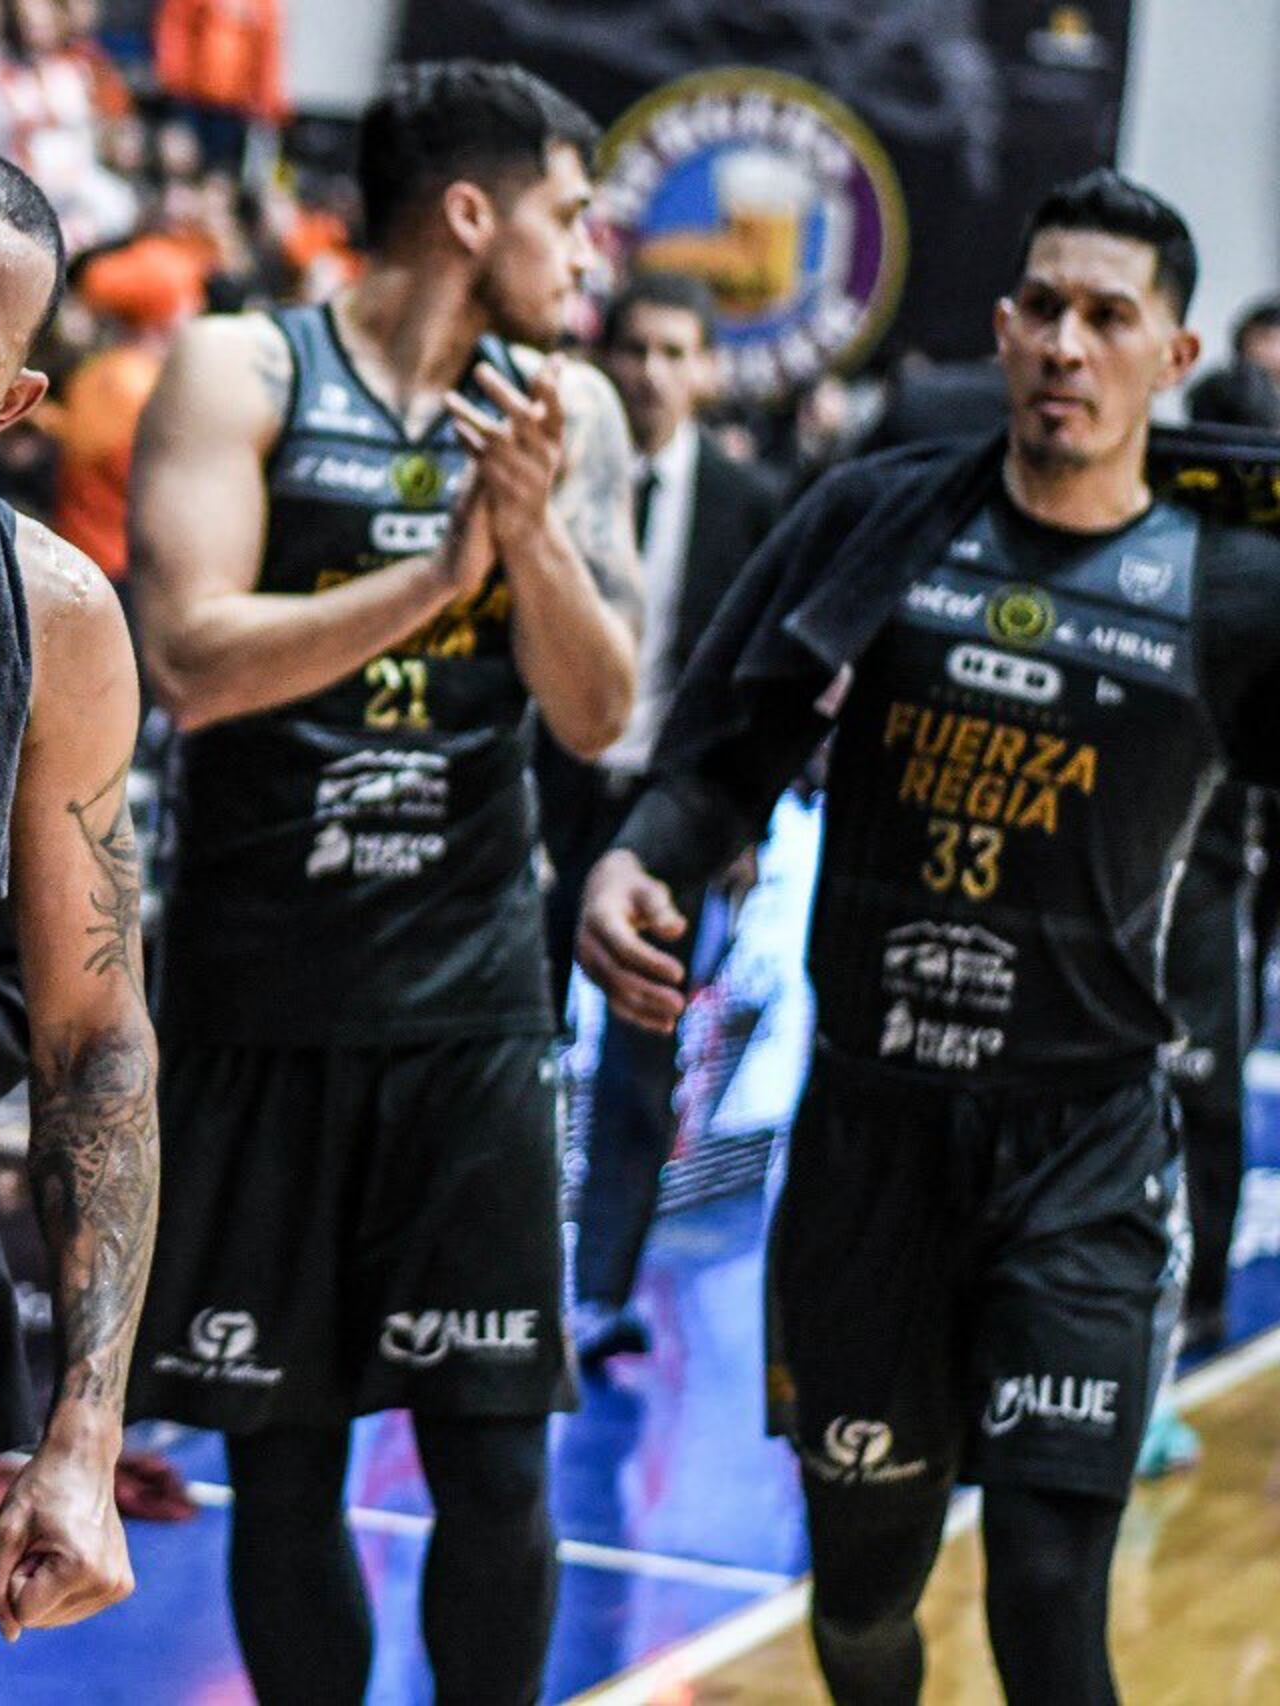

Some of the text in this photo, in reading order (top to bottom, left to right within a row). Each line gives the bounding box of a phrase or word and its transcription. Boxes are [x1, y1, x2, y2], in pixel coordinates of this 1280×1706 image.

[365, 657, 431, 731] 21
[883, 701, 1098, 796] FUERZA
[899, 756, 1058, 834] REGIA
[922, 820, 1004, 900] 33
